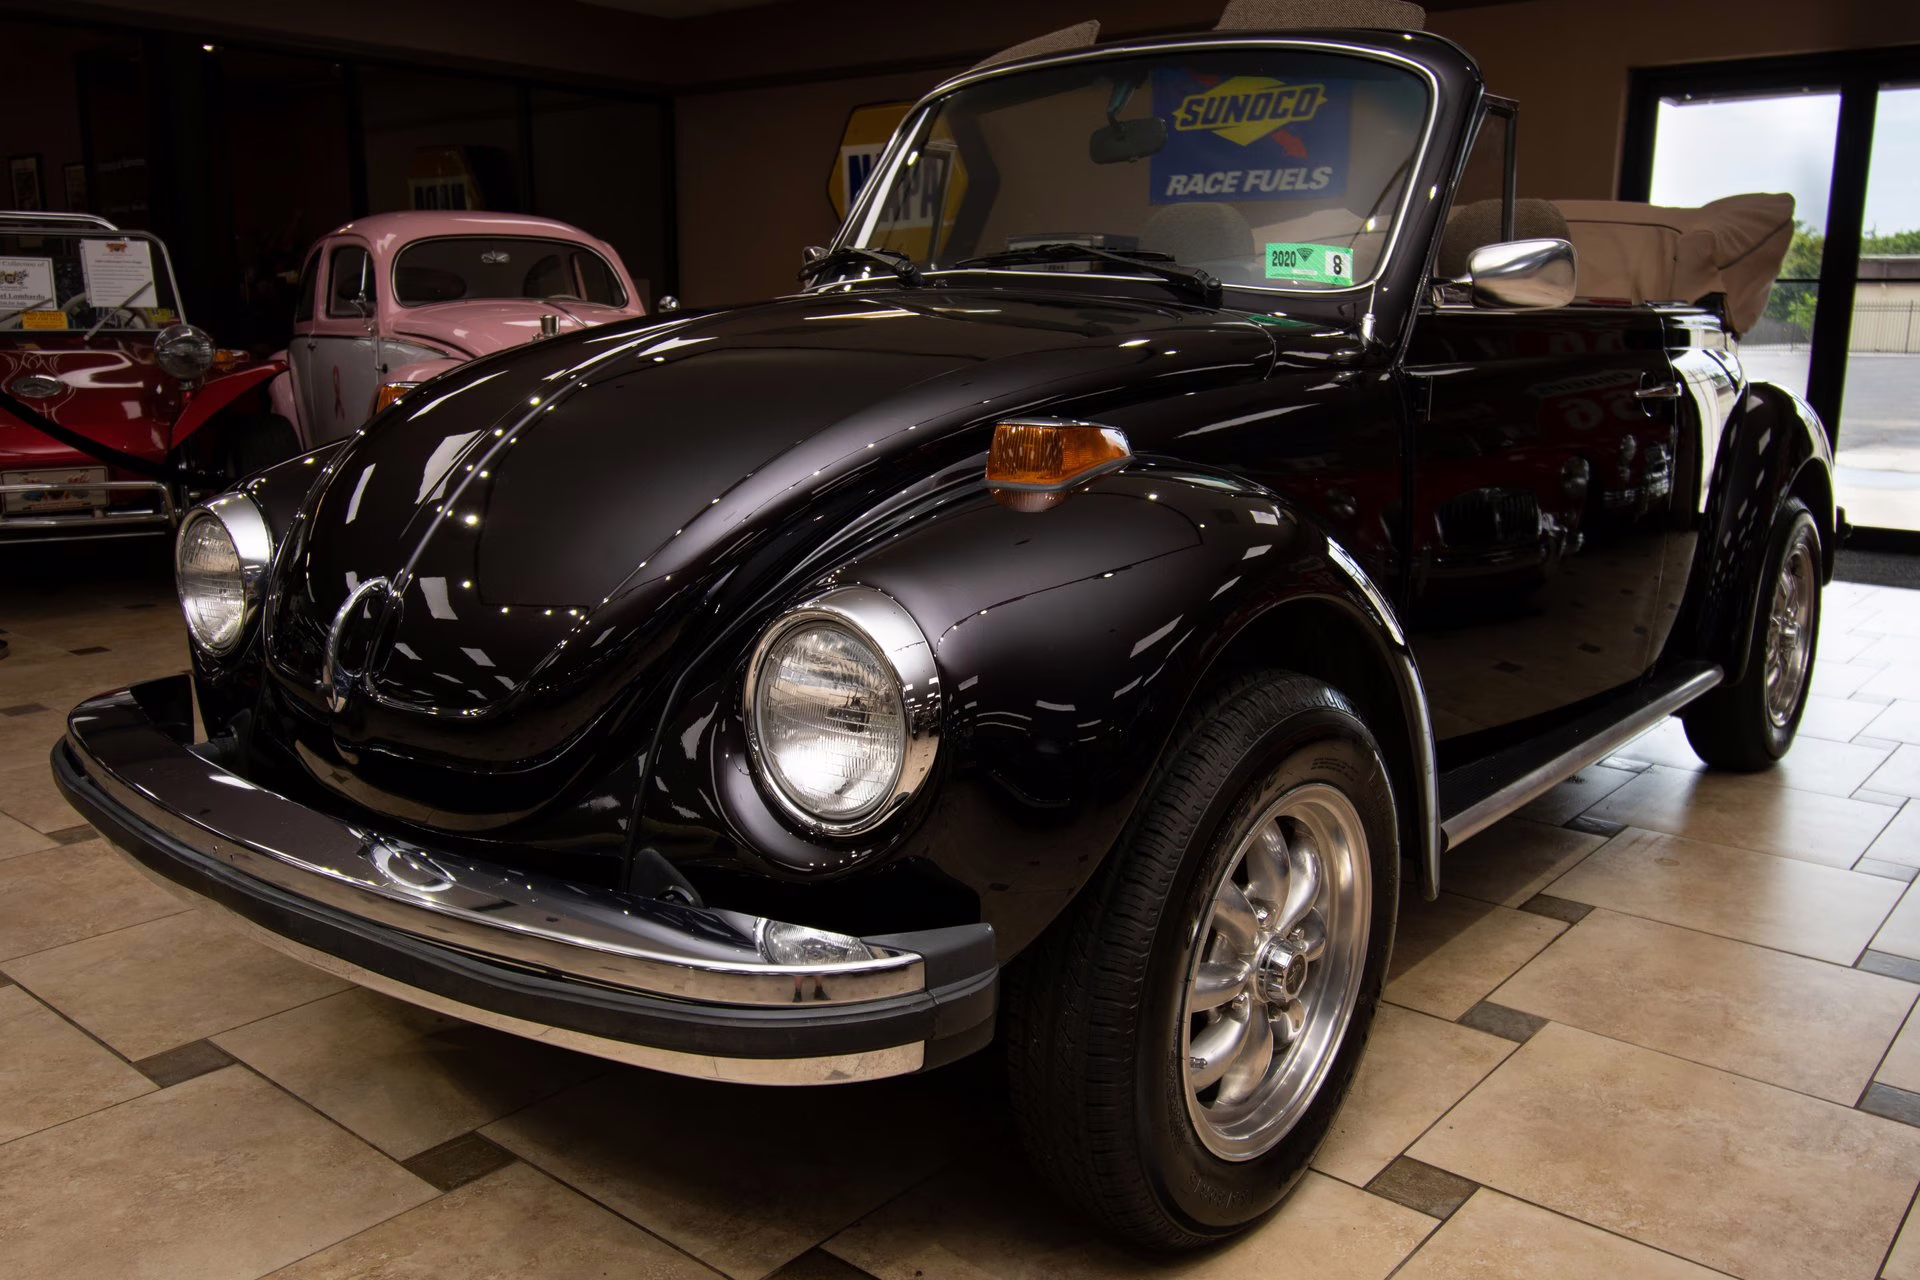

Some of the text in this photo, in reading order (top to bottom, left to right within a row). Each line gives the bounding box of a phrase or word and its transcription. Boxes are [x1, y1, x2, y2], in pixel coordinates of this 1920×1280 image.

[1179, 87, 1322, 127] SUNOCO
[1165, 166, 1333, 196] RACE FUELS
[1272, 250, 1296, 267] 2020
[1333, 255, 1342, 275] 8
